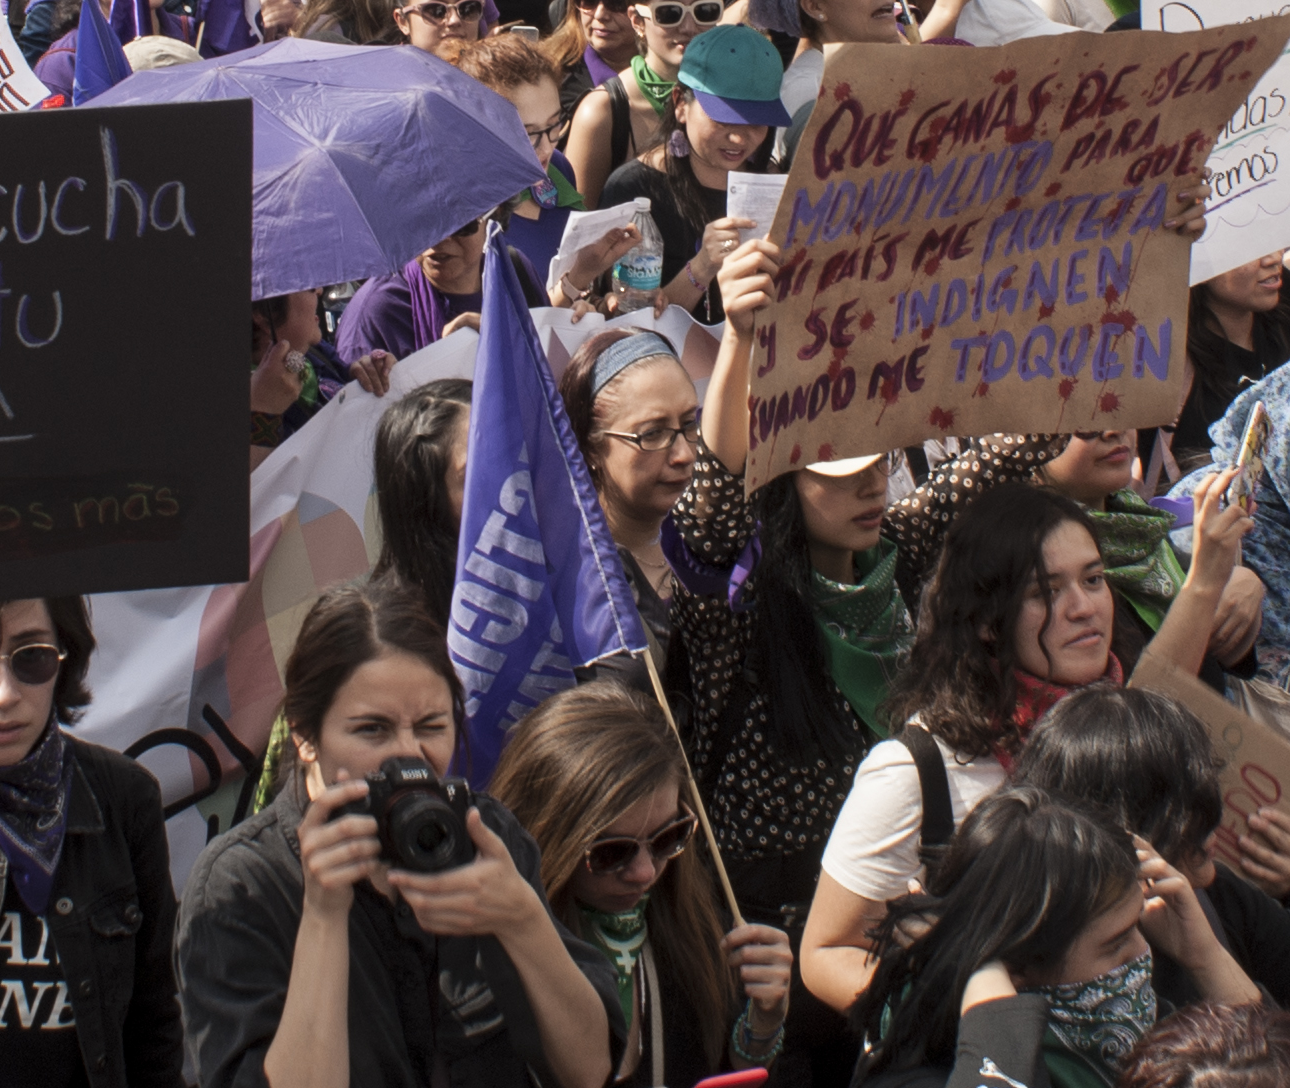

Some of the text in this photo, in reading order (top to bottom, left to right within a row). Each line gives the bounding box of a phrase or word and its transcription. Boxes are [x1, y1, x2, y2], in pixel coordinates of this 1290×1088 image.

[906, 64, 1140, 164] GANAS DE
[1123, 139, 1199, 188] QUE
[782, 112, 1161, 250] MONUMENTO PARA
[815, 181, 1169, 296] PAÍS ME PROTEJA
[797, 239, 1134, 361] SE INDIGNEN
[866, 316, 1174, 403] ME TOQUEN
[70, 481, 183, 532] más
